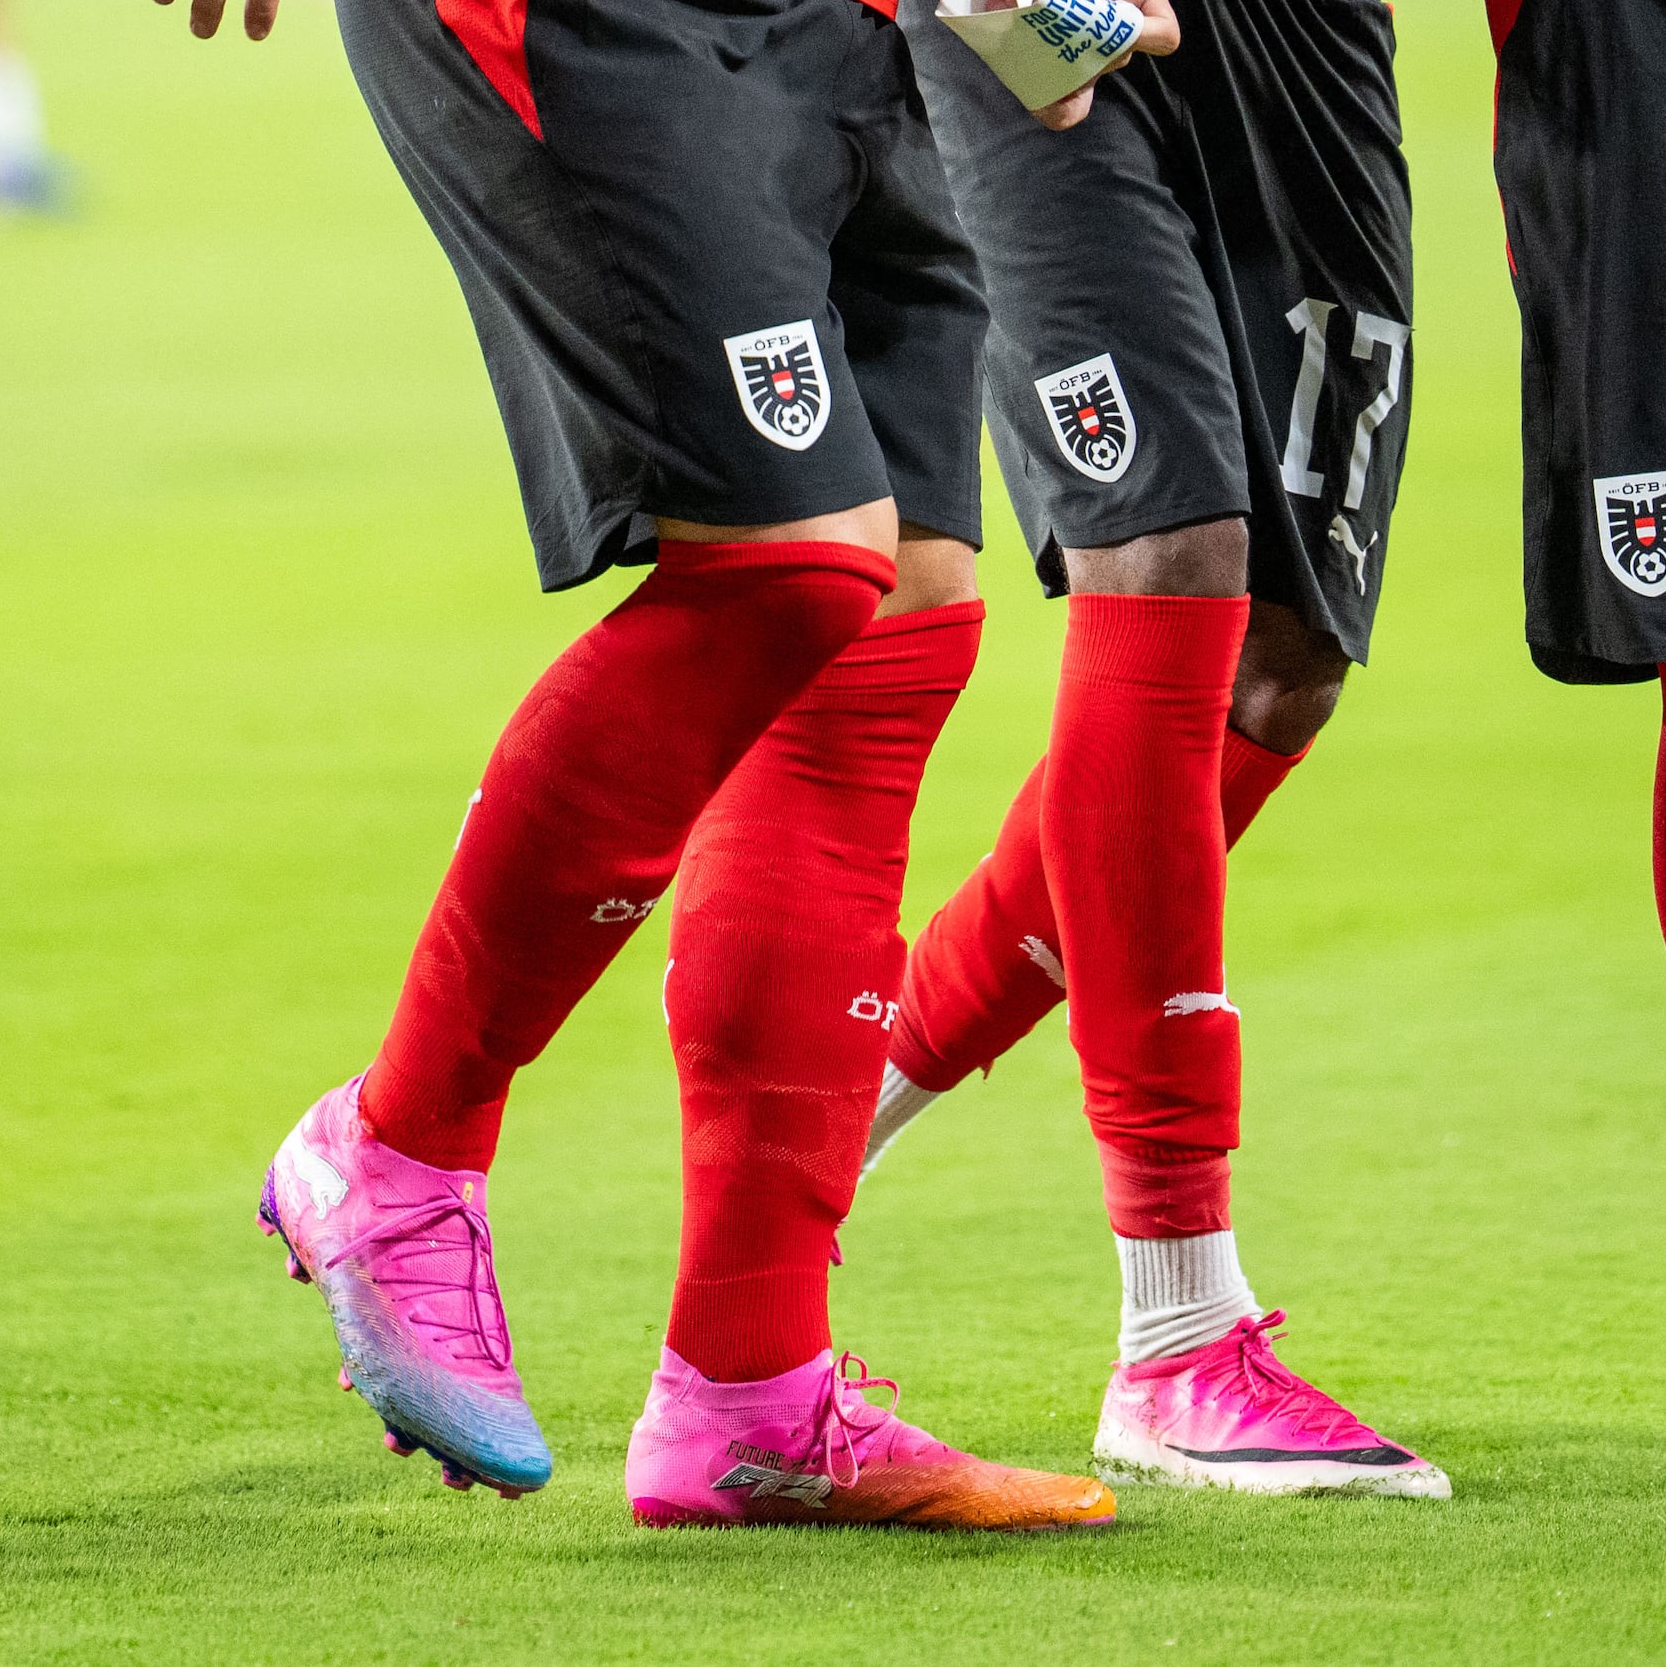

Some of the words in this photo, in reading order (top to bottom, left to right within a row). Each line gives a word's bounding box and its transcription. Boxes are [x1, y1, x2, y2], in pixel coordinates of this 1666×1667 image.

[1057, 38, 1092, 64] the
[1101, 24, 1132, 55] FIFA
[754, 334, 790, 351] ÖFB
[1059, 371, 1091, 390] ÖFB
[1279, 296, 1416, 510] 17
[1622, 481, 1660, 495] ÖFB
[846, 989, 900, 1032] ÖF
[726, 1439, 786, 1471] FUTURE
